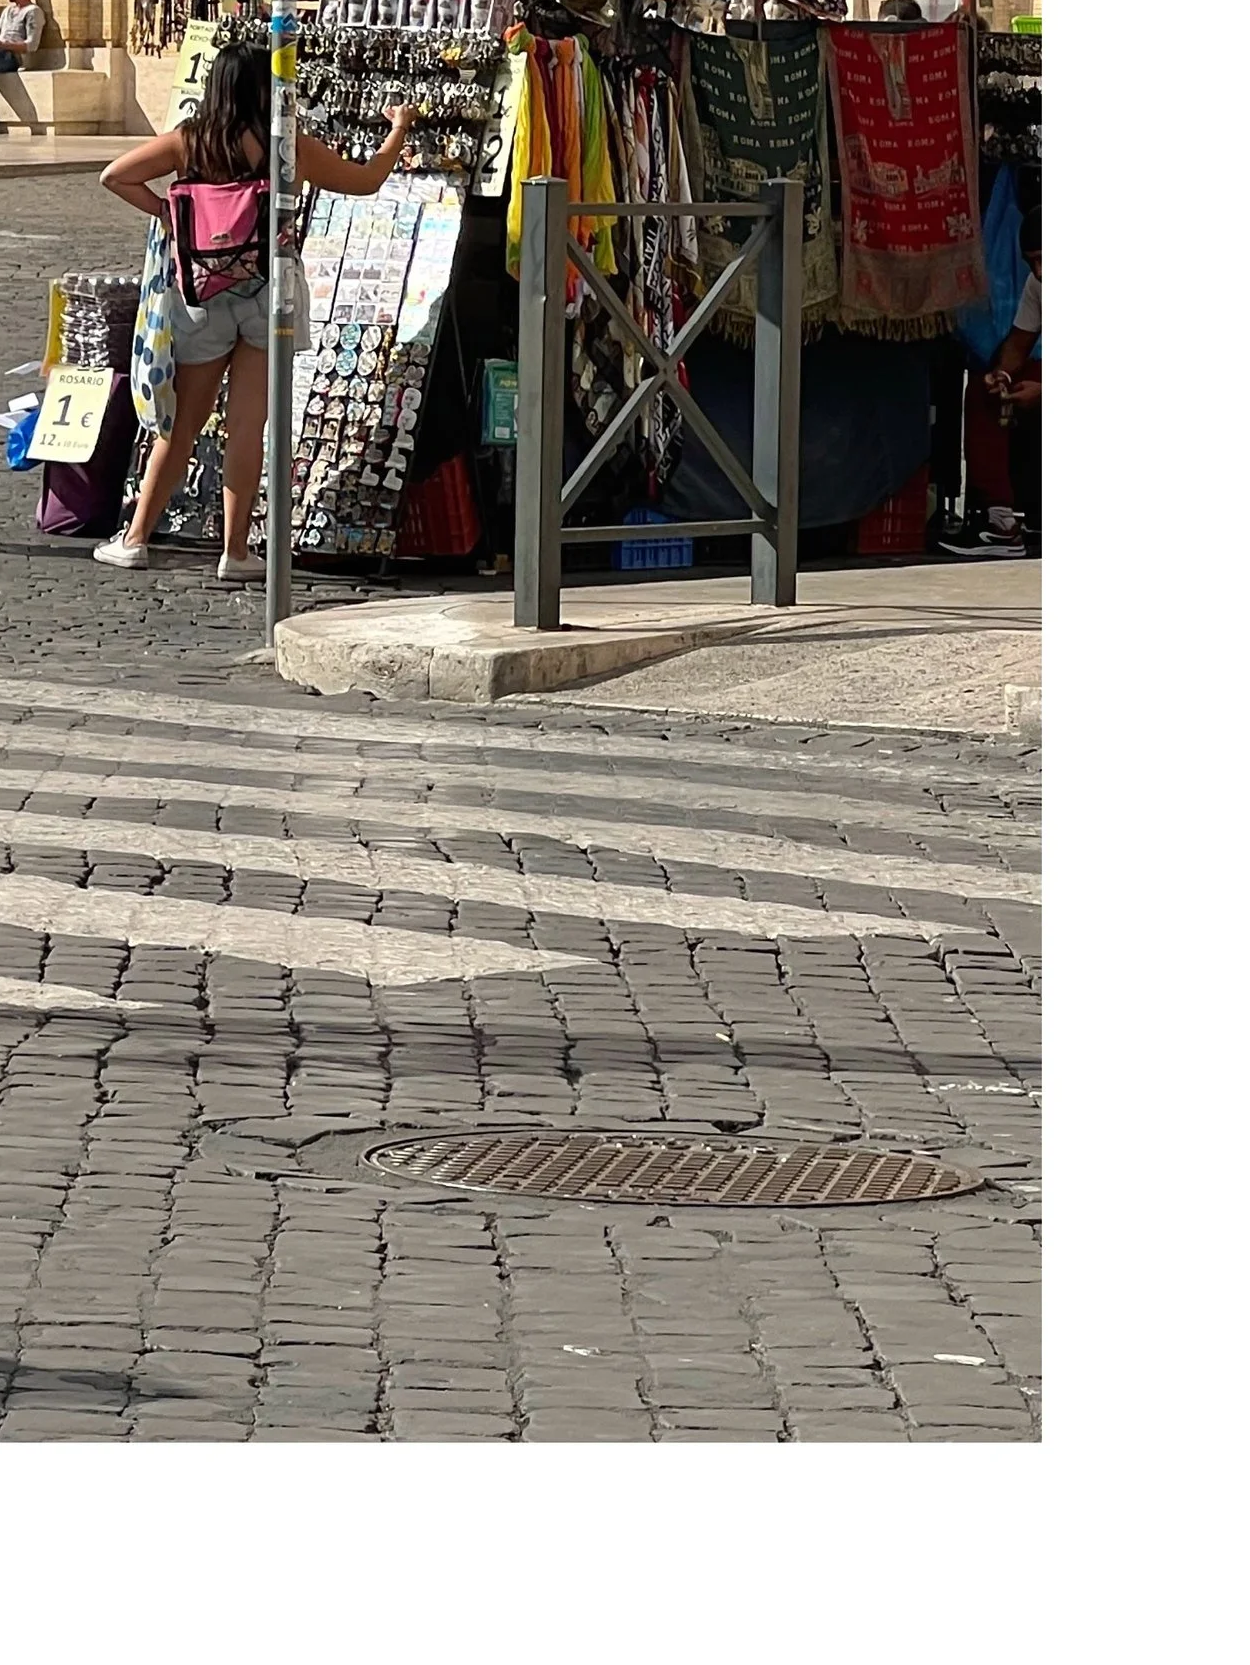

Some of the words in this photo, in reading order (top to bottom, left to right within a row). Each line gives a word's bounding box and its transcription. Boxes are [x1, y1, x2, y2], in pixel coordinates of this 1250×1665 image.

[184, 52, 202, 84] 1
[59, 374, 104, 386] ROSARIO
[51, 394, 73, 426] 1
[39, 433, 56, 446] 12
